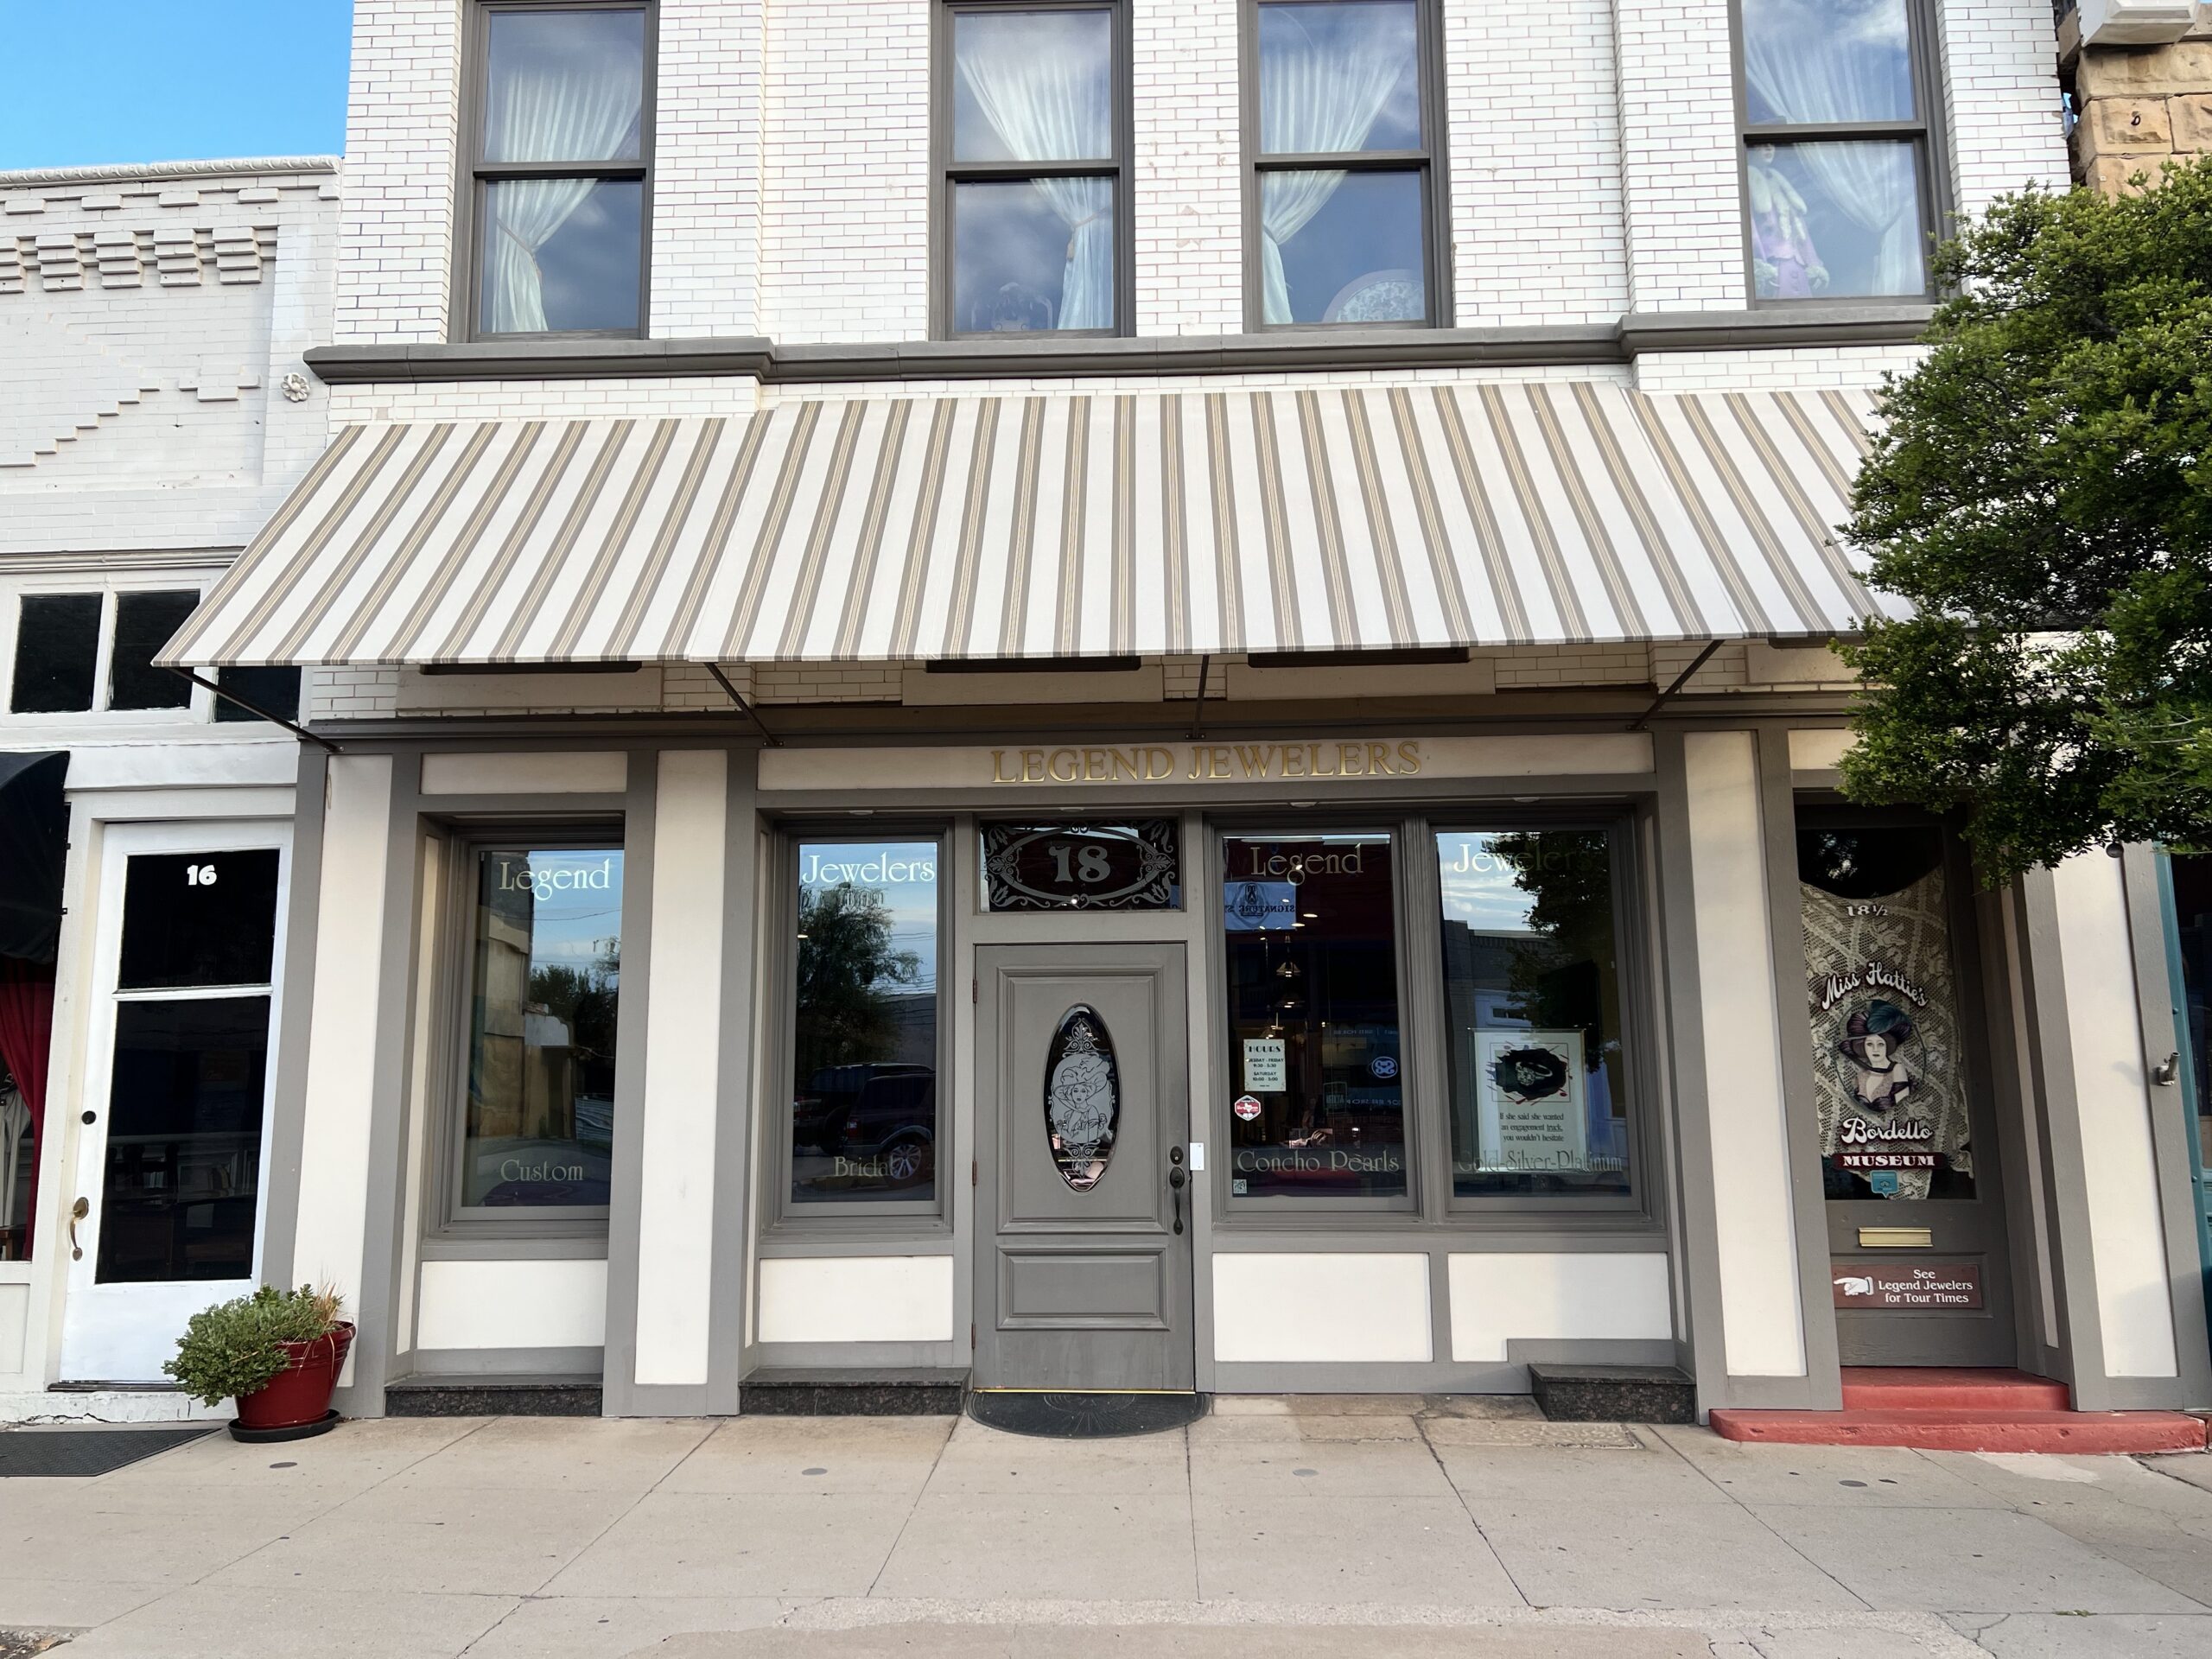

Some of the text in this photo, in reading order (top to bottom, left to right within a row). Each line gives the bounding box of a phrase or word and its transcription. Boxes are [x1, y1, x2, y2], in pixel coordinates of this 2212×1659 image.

[991, 741, 1422, 783] LEGEND JEWELERS
[187, 865, 217, 886] 16
[802, 852, 936, 885] Jewelers
[1048, 845, 1111, 883] 18
[1250, 842, 1363, 886] Legend
[499, 859, 610, 901] Legend
[1821, 962, 1929, 1010] Miss Hattie's
[1841, 1116, 1933, 1143] Bordello
[500, 1160, 583, 1182] Custom
[1237, 1150, 1400, 1173] Concho Pearls
[1842, 1155, 1935, 1166] MUSEUM
[1913, 1269, 1936, 1279] See
[1878, 1281, 1974, 1293] Legend Jewelers
[1885, 1293, 1969, 1303] for Tour Times
